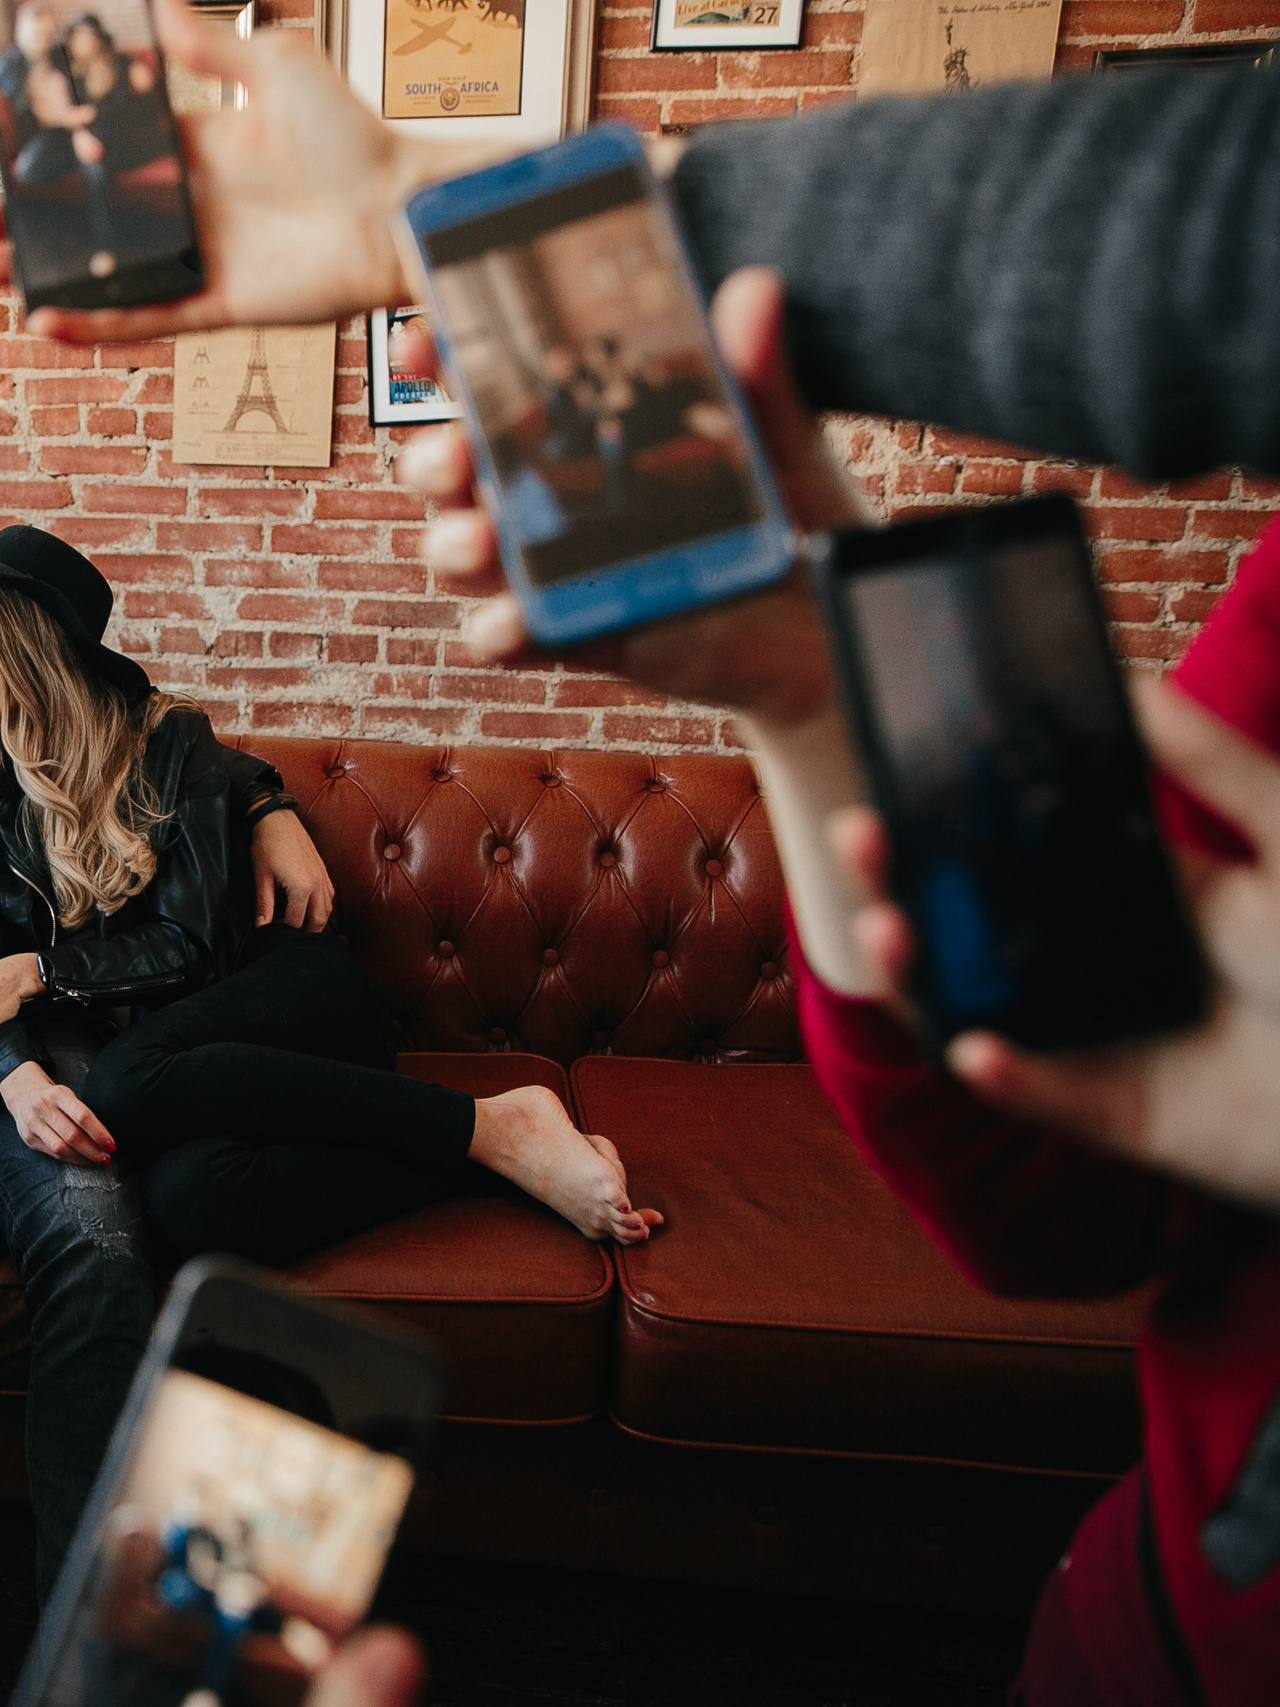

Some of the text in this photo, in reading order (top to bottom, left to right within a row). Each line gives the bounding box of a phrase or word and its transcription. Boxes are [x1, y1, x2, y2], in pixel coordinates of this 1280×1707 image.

[678, 4, 699, 15] Live
[754, 7, 778, 24] 27
[405, 81, 499, 95] SOUTH AFRICA
[394, 380, 431, 393] APOLLO
